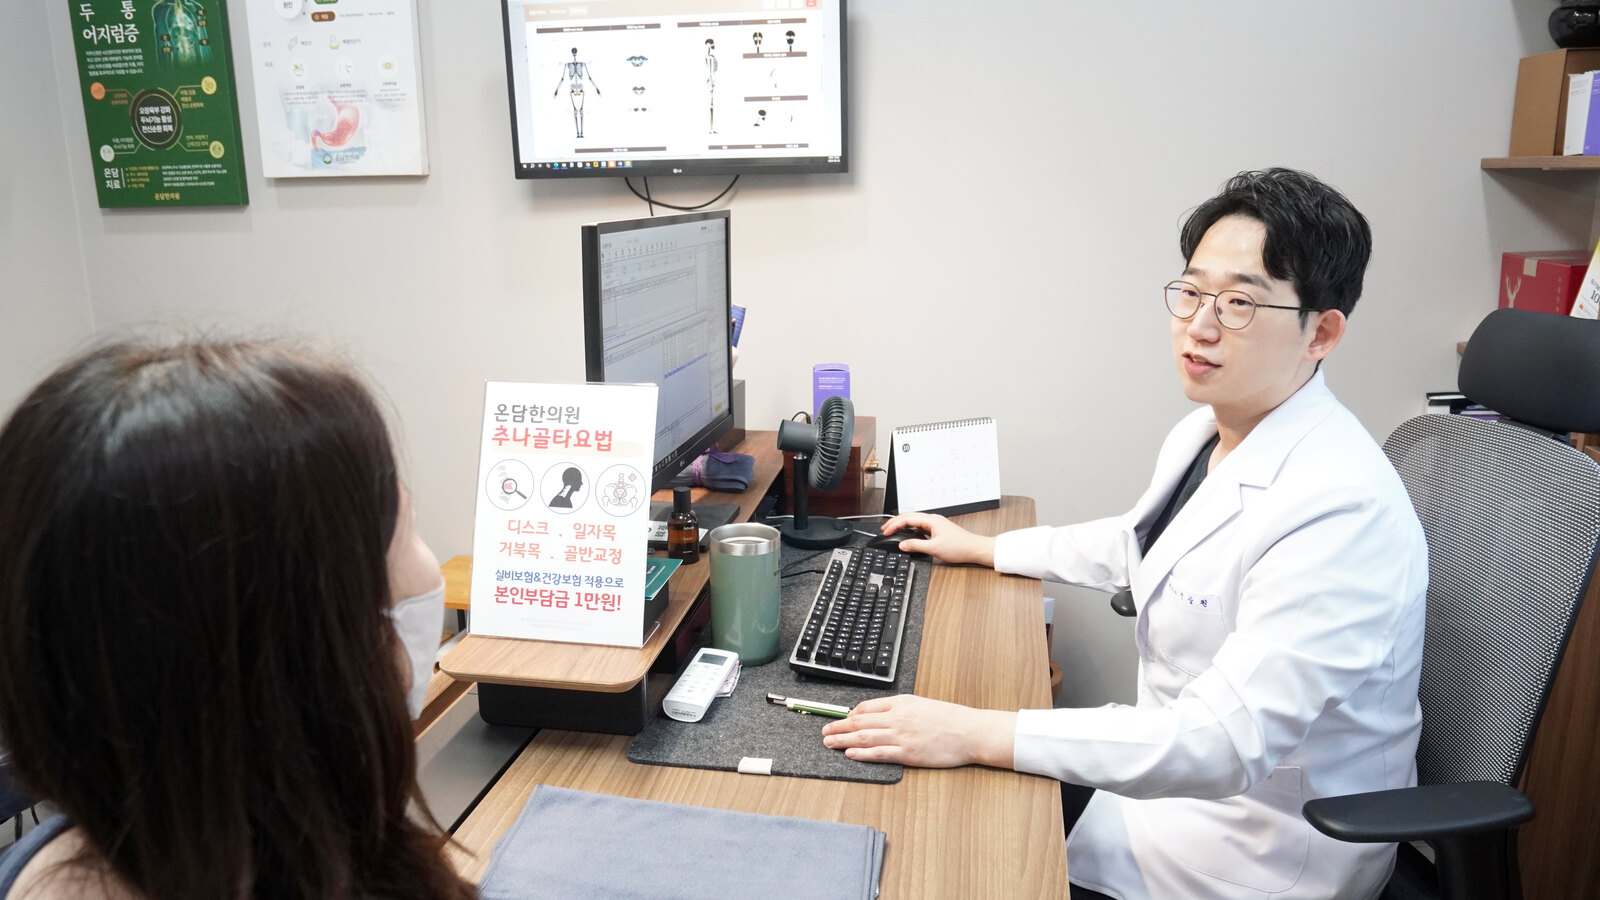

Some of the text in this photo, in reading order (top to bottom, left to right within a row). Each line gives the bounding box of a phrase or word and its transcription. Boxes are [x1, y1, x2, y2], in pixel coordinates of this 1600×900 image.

[79, 0, 137, 22] 두 통
[82, 23, 140, 45] 어지럼증
[103, 167, 119, 178] 온담
[105, 179, 122, 190] 치료
[494, 403, 580, 425] 온담한의원
[491, 425, 613, 452] 추나골타요법
[507, 519, 549, 535] 디스크
[572, 522, 617, 541] 일자목
[499, 541, 541, 559] 거북목
[564, 545, 622, 565] 골반교정
[495, 569, 624, 588] 실비보험&건강보험 적용으로
[494, 585, 622, 612] 본인부담금 1만원!
